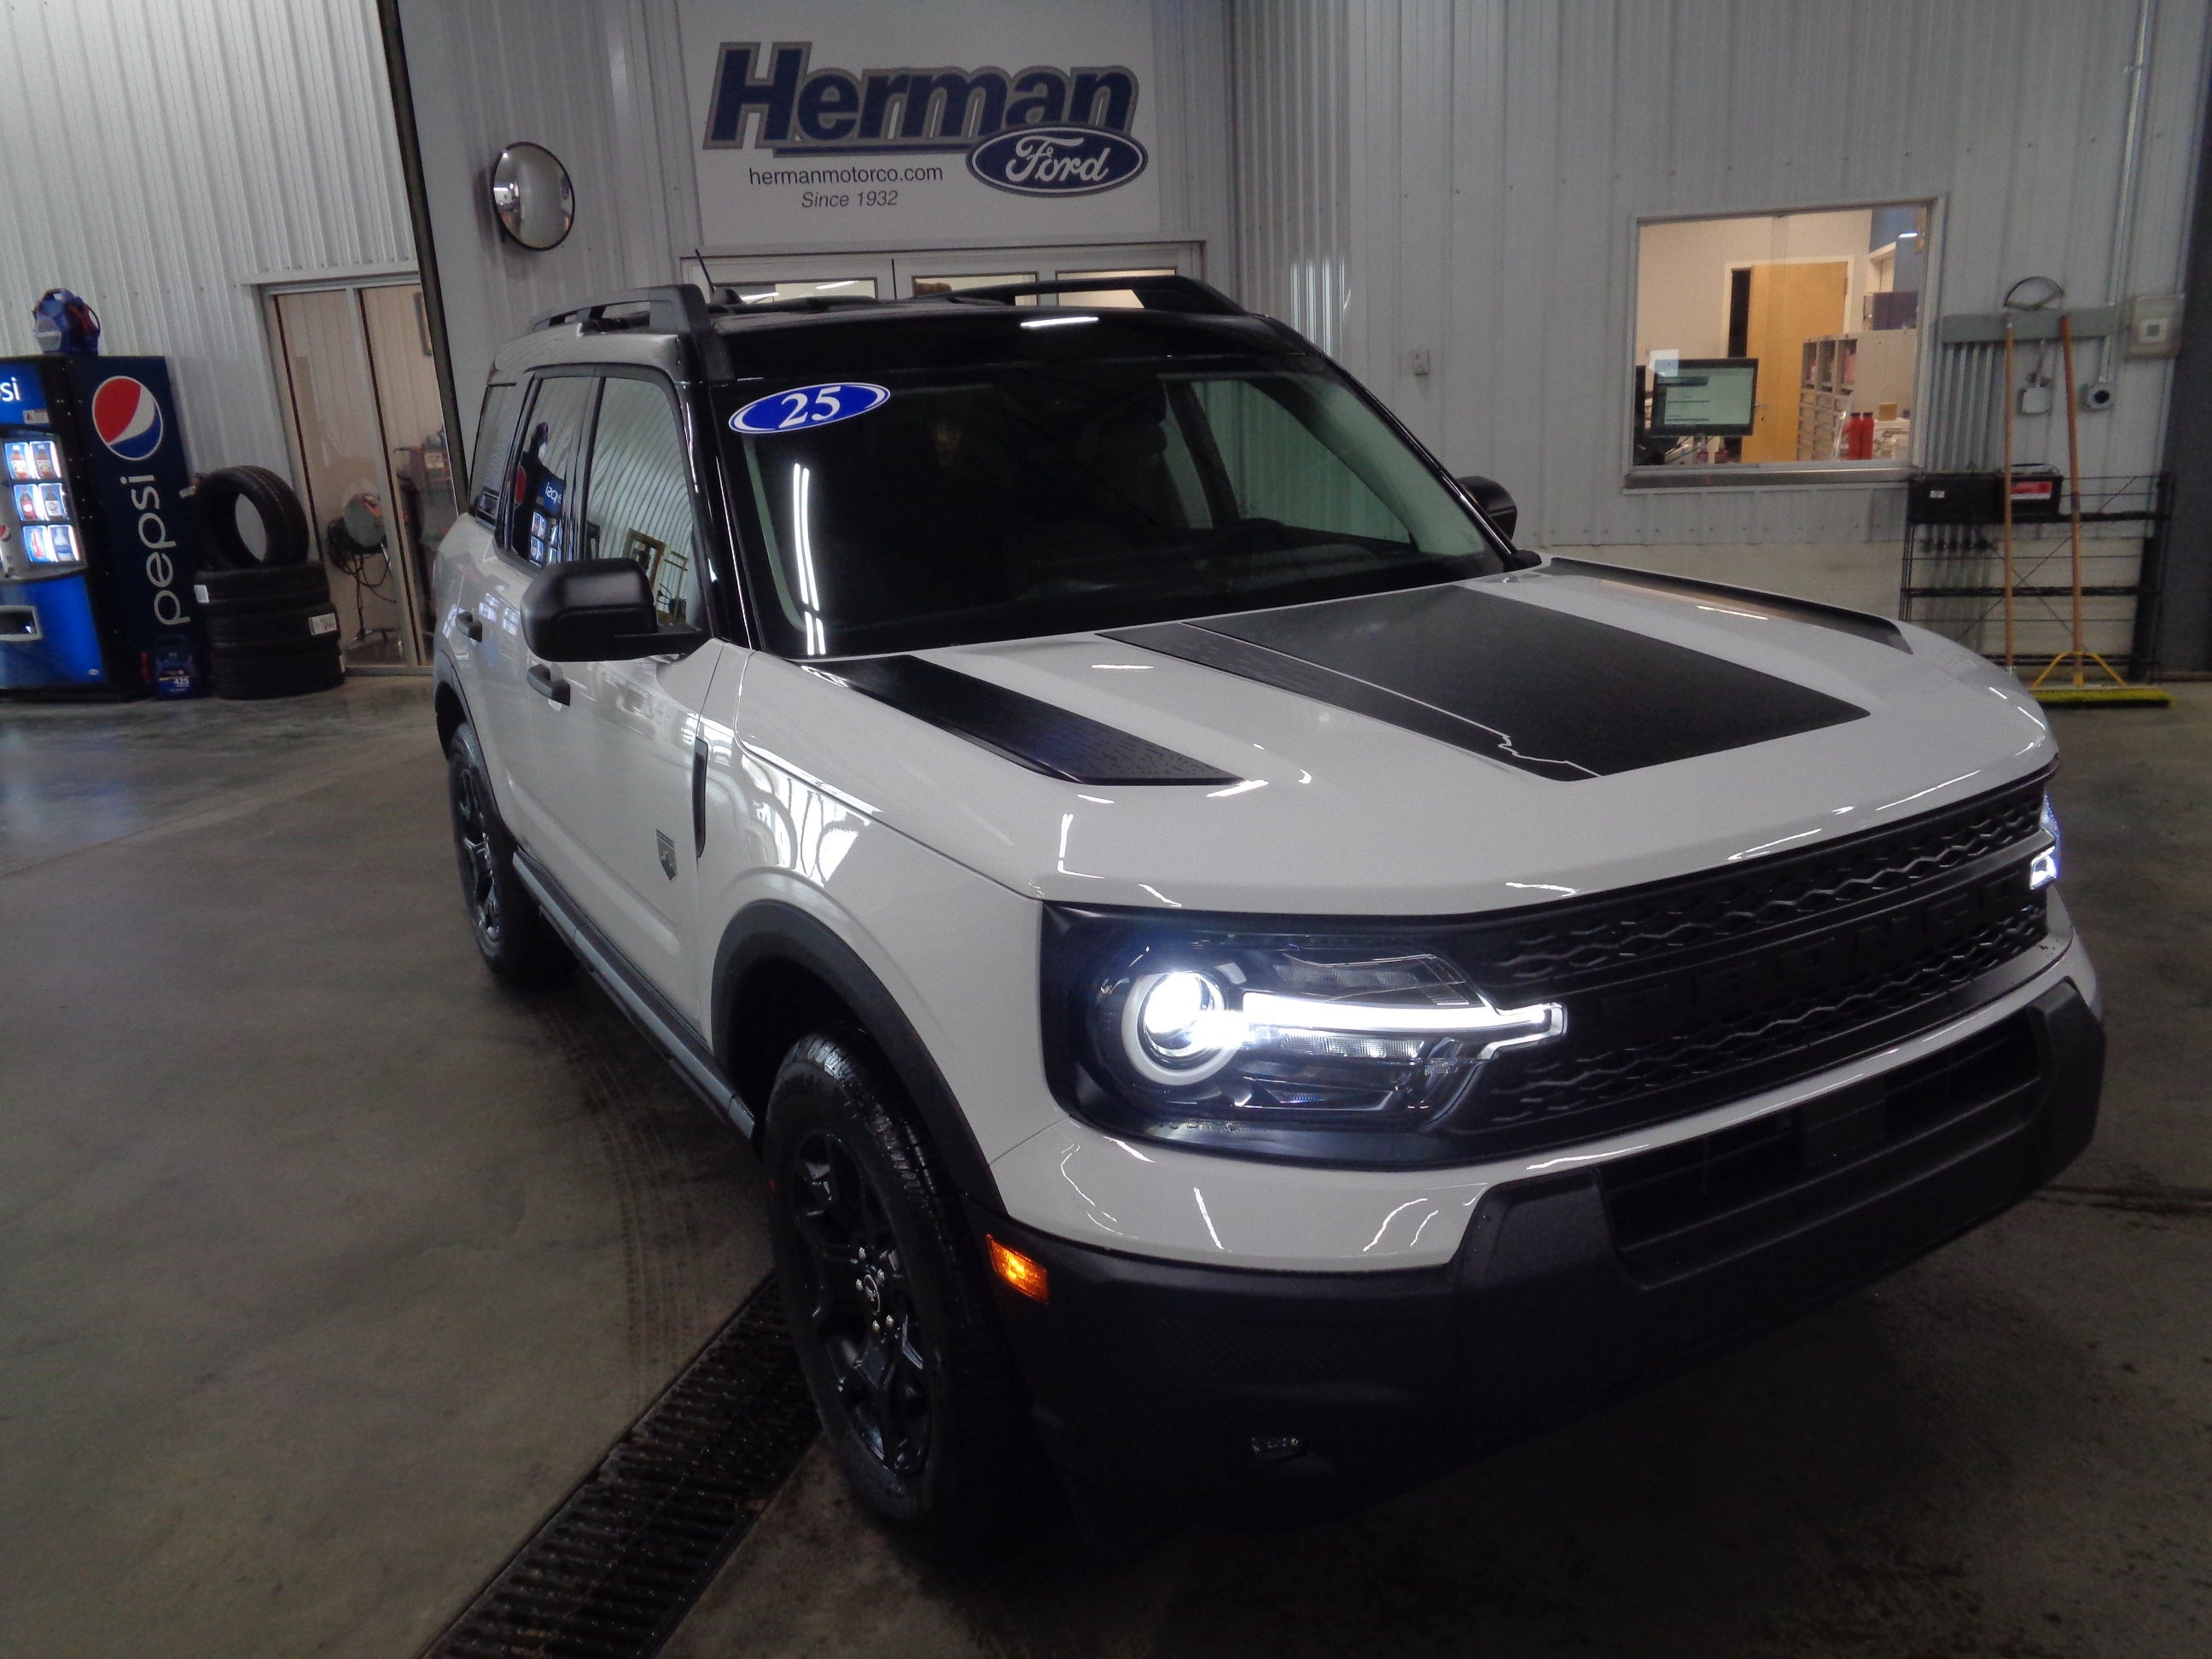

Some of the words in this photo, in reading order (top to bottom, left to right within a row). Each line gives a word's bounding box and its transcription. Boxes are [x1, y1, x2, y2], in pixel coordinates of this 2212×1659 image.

[704, 42, 1138, 149] Herman
[748, 166, 943, 185] hermanmotorco.com
[1005, 135, 1111, 182] Ford
[800, 191, 850, 208] Since
[856, 189, 899, 207] 1932
[778, 386, 841, 428] 25
[119, 474, 191, 626] pepsi
